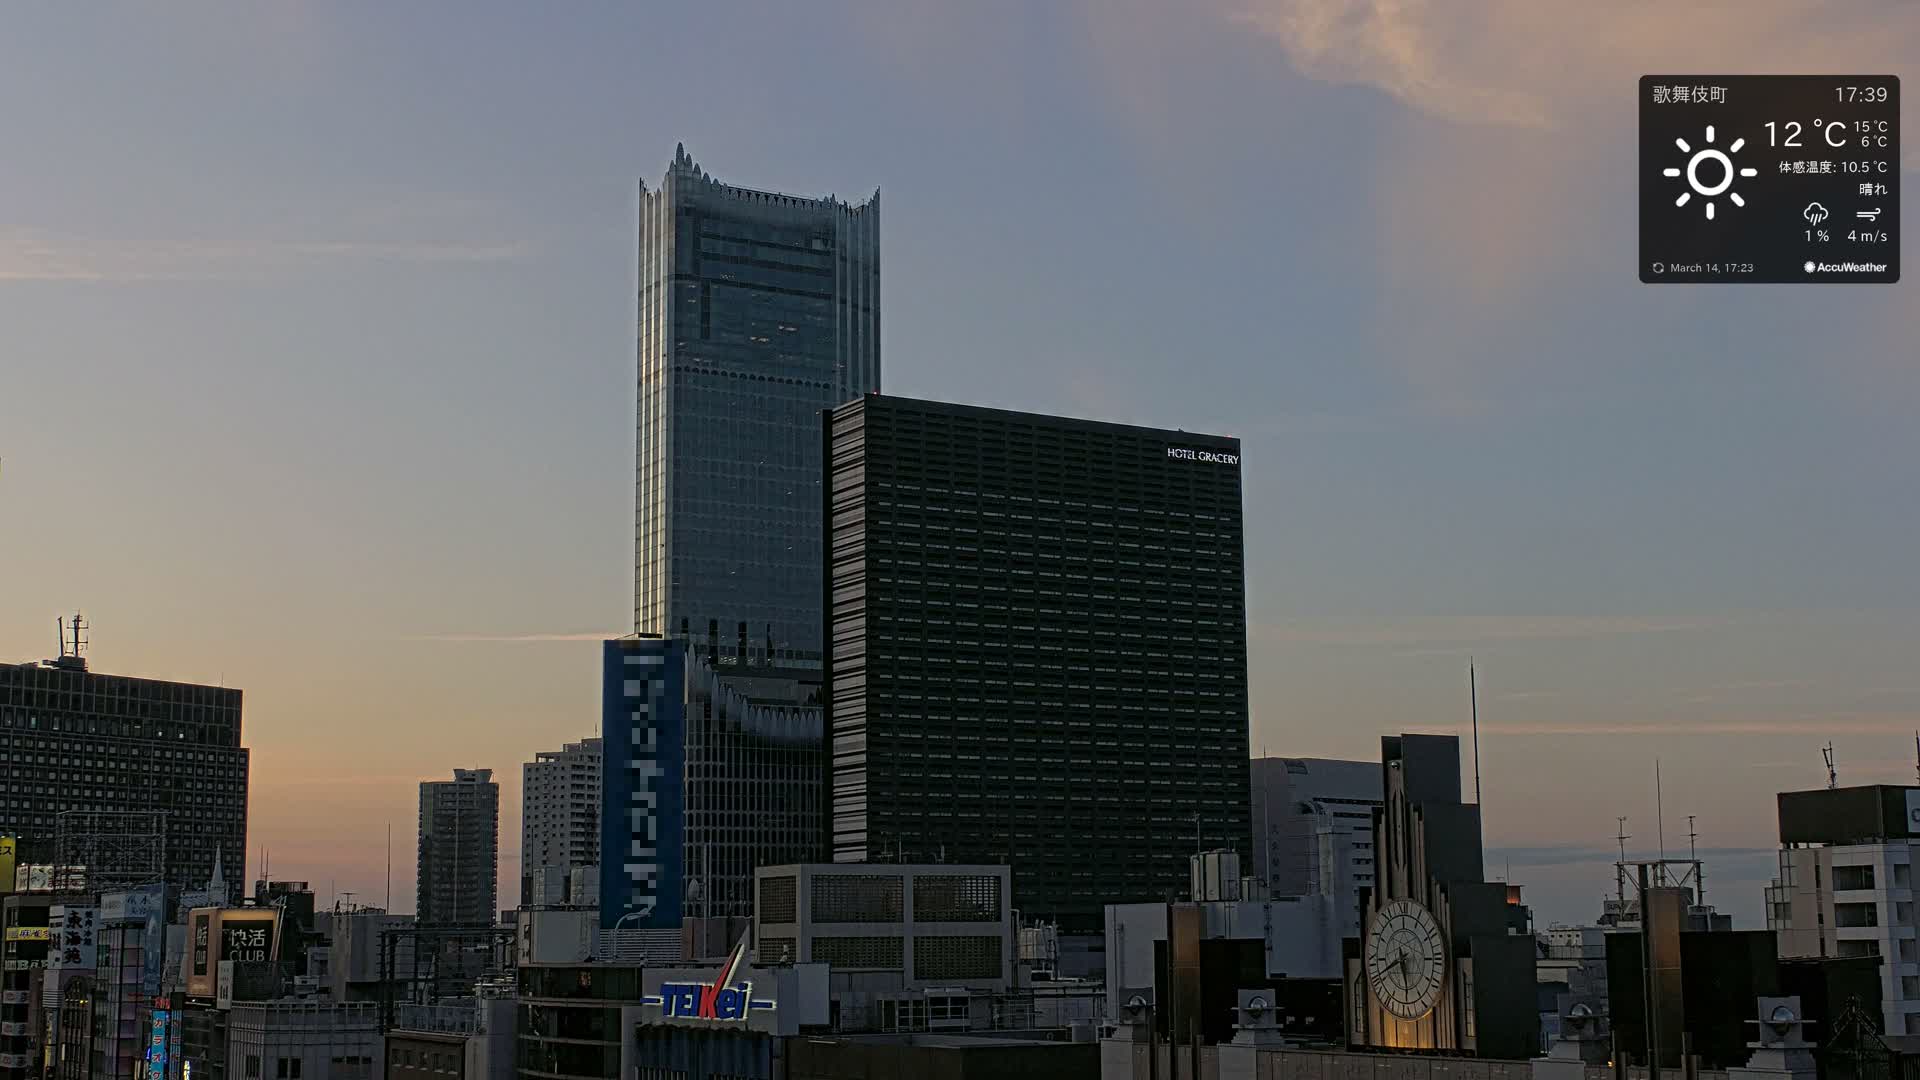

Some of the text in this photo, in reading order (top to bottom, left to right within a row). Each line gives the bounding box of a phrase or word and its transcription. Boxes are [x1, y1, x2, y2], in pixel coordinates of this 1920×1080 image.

[1167, 448, 1239, 464] HOTEL GRACERY
[231, 929, 266, 947] 快活
[229, 950, 265, 962] CLUB
